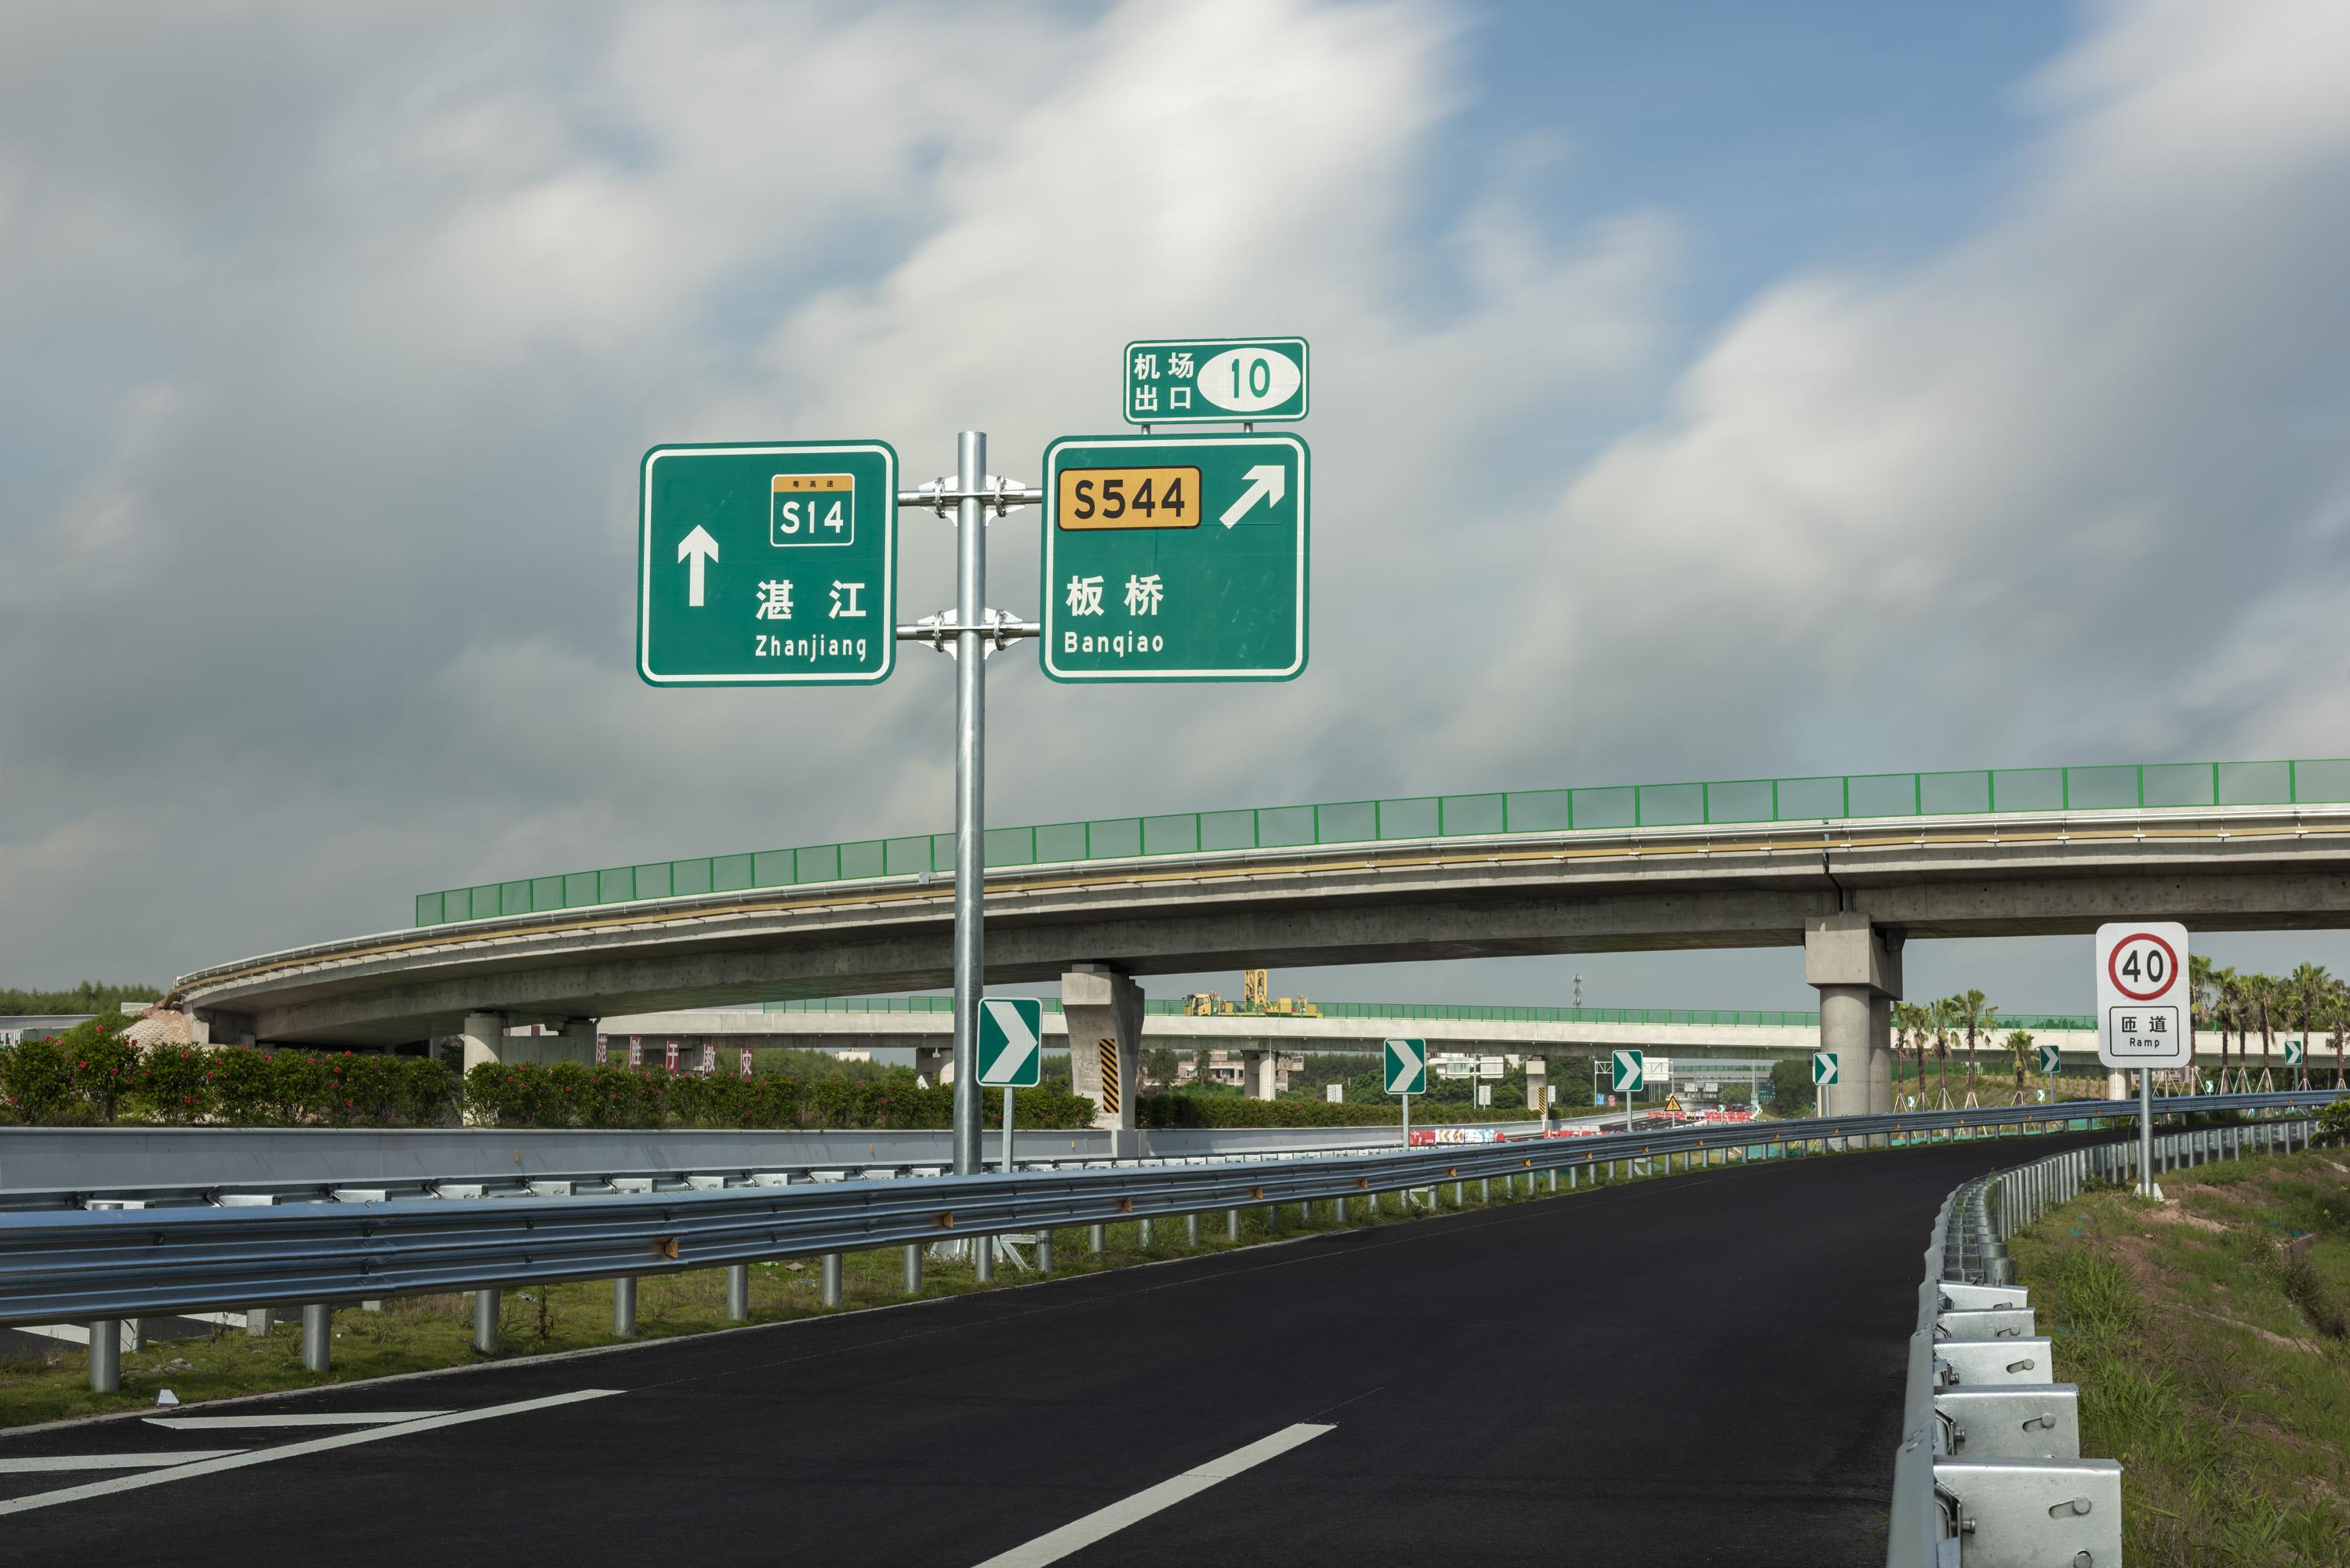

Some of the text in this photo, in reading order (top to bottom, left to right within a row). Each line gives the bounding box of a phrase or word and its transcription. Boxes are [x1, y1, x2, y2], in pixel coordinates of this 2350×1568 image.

[1134, 352, 1194, 380] 机场
[1231, 358, 1270, 399] 10
[1135, 384, 1192, 412] 出口
[1073, 477, 1186, 520] S544
[780, 500, 844, 534] S14
[755, 579, 866, 620] 湛江
[1066, 573, 1164, 617] 板桥
[755, 633, 866, 662] Zhanjiang
[1064, 630, 1164, 659] Banqiao
[2122, 949, 2163, 982] 40
[2121, 1016, 2167, 1033] 匝道
[2130, 1037, 2159, 1048] Ramp
